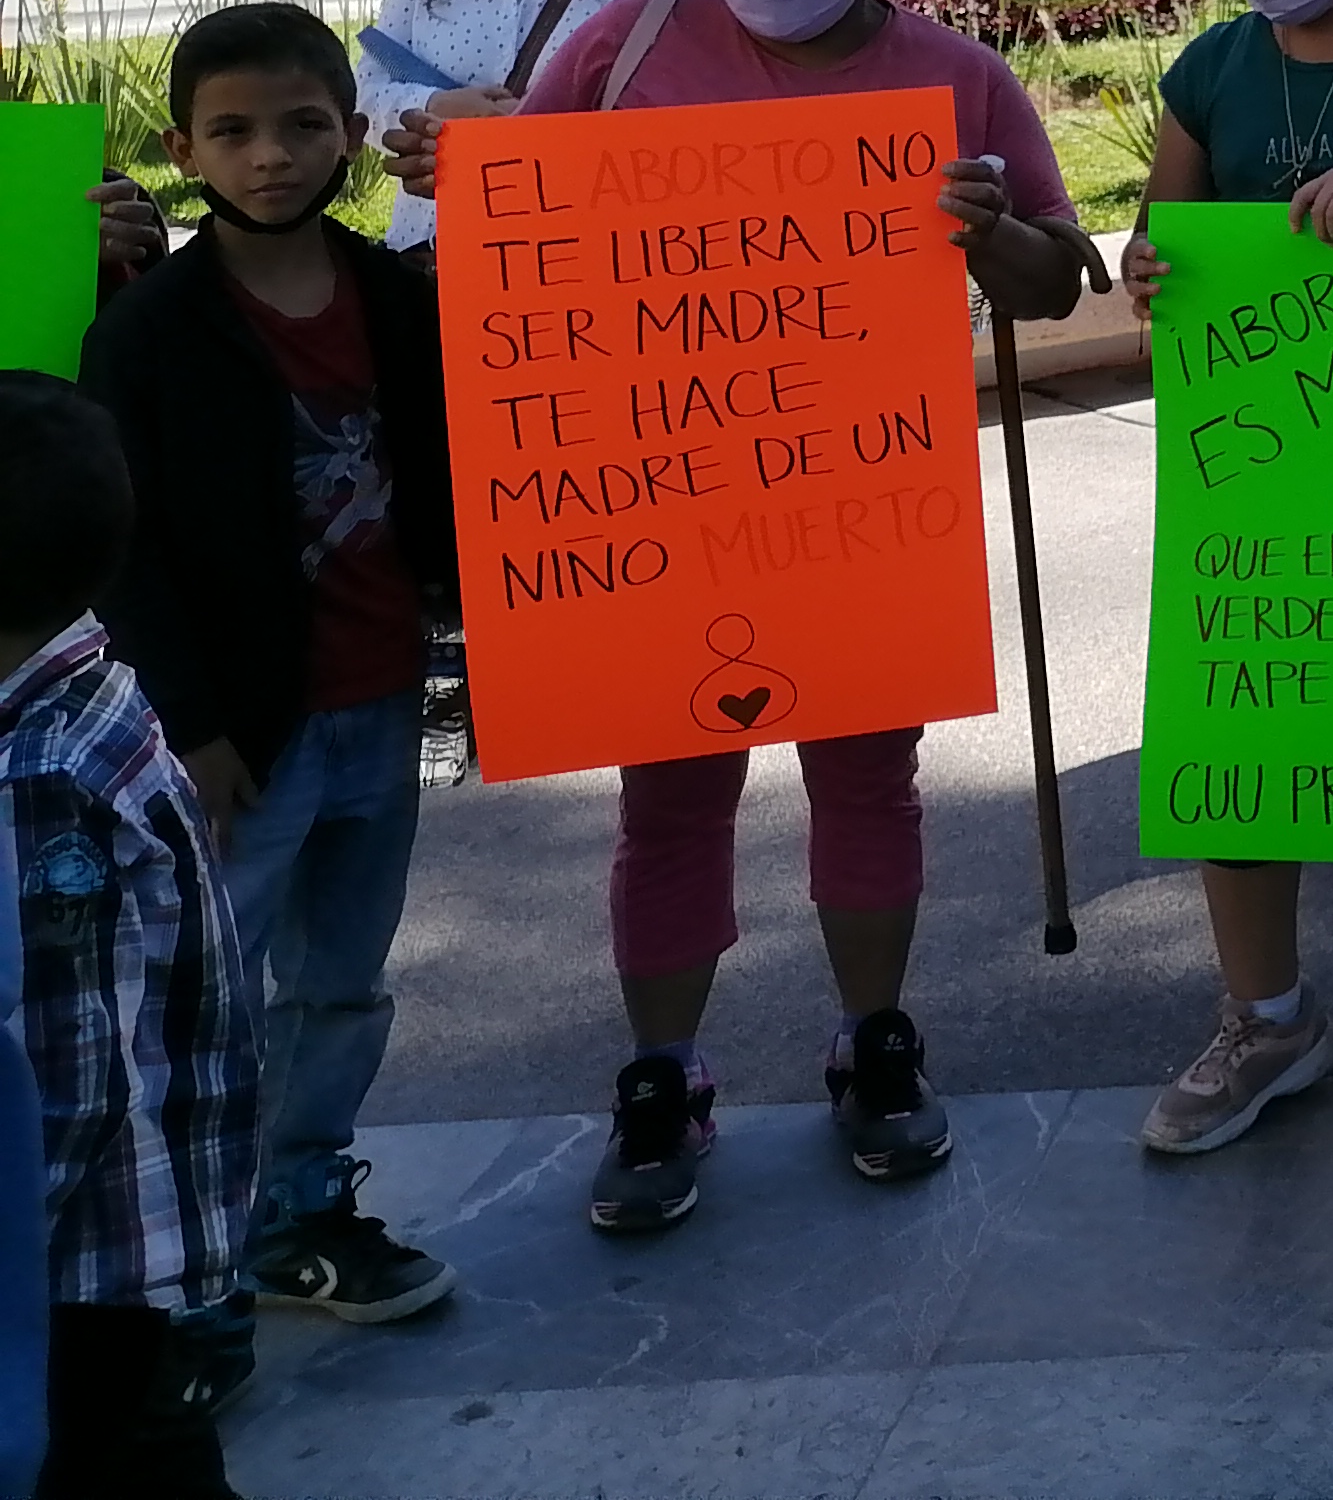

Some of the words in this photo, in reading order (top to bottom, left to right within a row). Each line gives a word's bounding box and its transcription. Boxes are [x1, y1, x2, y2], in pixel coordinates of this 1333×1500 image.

[481, 158, 573, 219] EL
[590, 138, 836, 208] ABORTO
[857, 130, 936, 187] NO
[482, 236, 583, 292] TE
[611, 213, 823, 285] LIBERA
[844, 206, 919, 258] DE
[482, 308, 612, 369] SER
[636, 280, 869, 355] MADRE,
[491, 389, 596, 450] TE
[630, 361, 823, 441] HACE
[1189, 404, 1283, 490] ES
[489, 445, 729, 525] MADRE
[754, 429, 835, 490] DE
[852, 393, 933, 466] UN
[501, 534, 670, 611] NIÑO
[699, 484, 962, 588] MUERTO
[1194, 534, 1287, 581] QUE
[1198, 659, 1332, 710] TAPE
[1168, 761, 1264, 825] CUU
